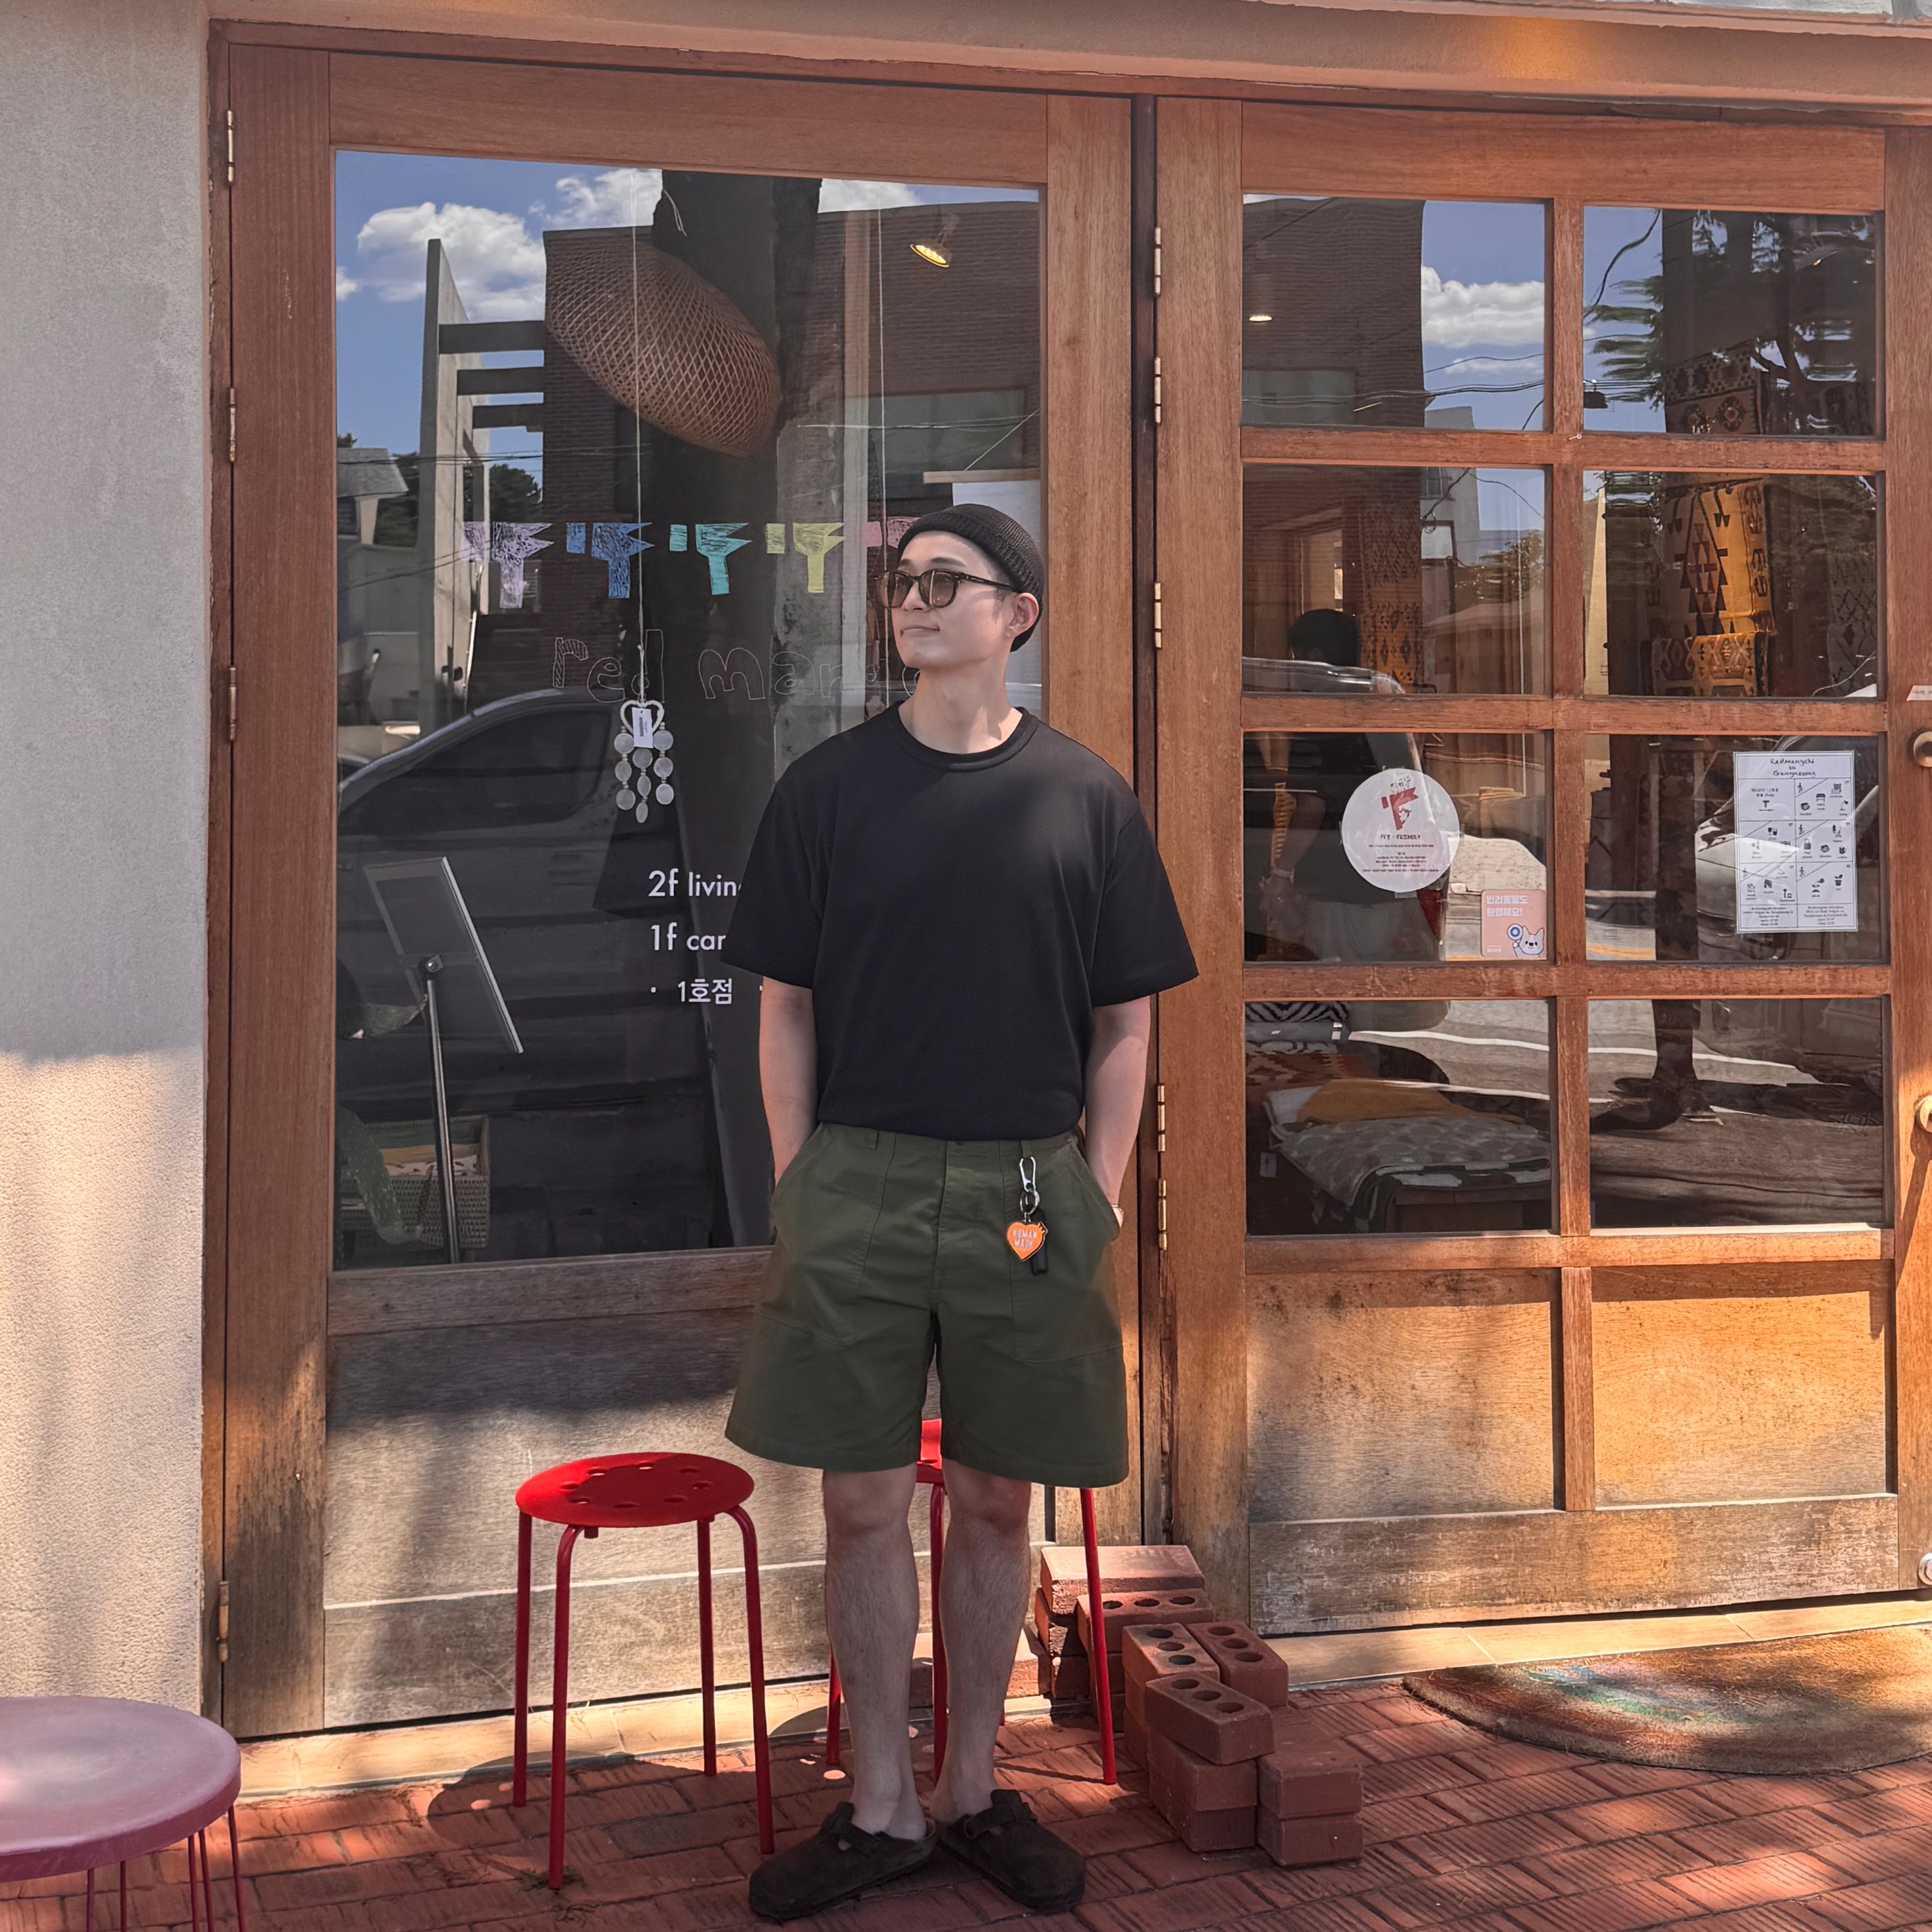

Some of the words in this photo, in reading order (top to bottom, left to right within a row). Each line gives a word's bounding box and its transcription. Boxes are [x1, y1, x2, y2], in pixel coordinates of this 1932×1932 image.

[649, 868, 679, 897] 2f
[688, 871, 742, 897] livin
[651, 922, 677, 951] 1f
[677, 977, 733, 1005] 1호점
